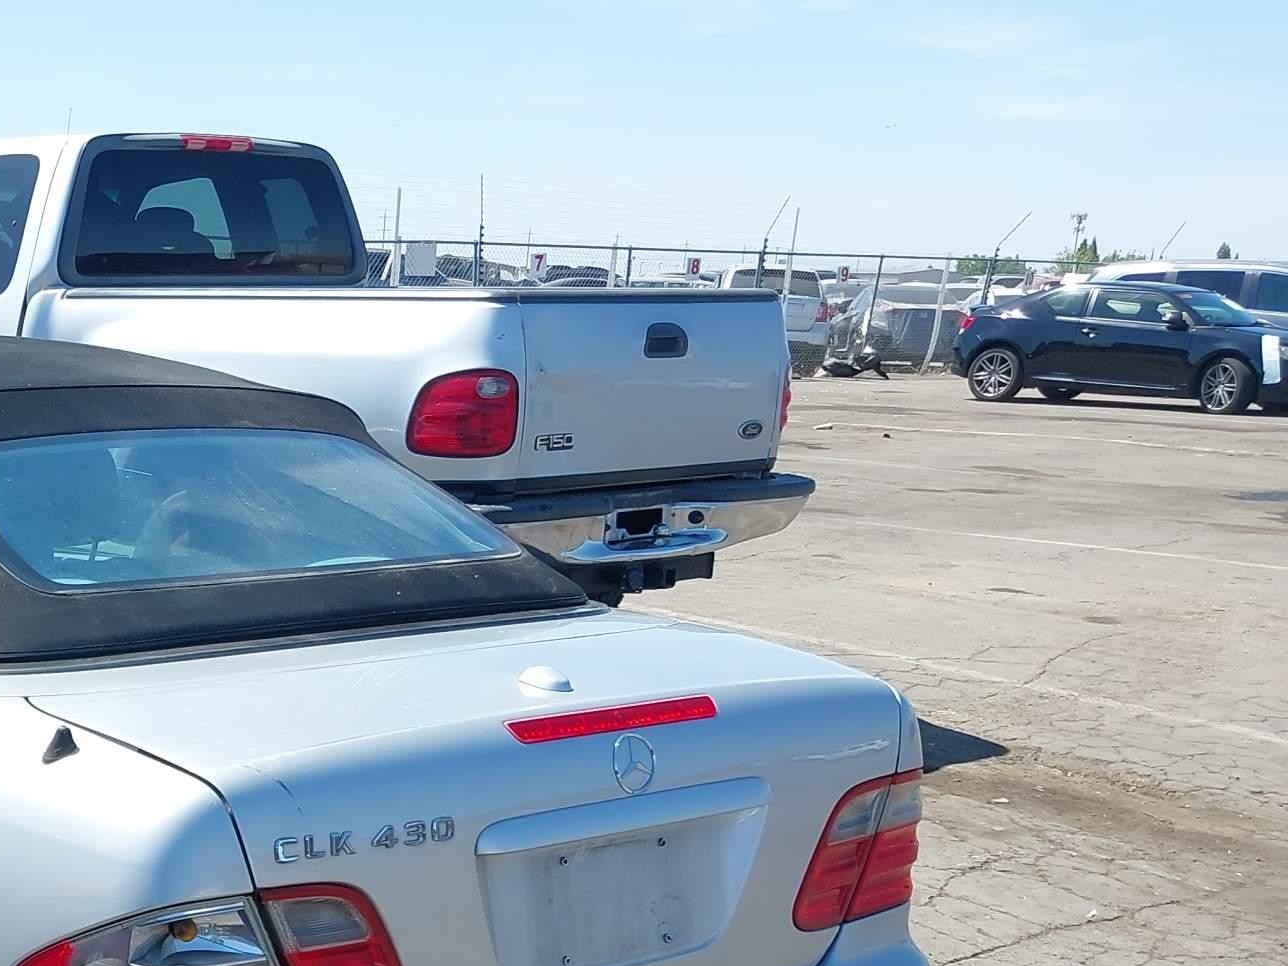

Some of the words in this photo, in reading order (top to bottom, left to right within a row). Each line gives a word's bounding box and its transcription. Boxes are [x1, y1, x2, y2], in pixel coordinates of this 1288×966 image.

[534, 254, 544, 272] 7
[690, 258, 701, 275] 8
[841, 266, 849, 282] 9
[535, 434, 574, 450] F150
[273, 830, 356, 864] CLK
[370, 816, 455, 849] 430
